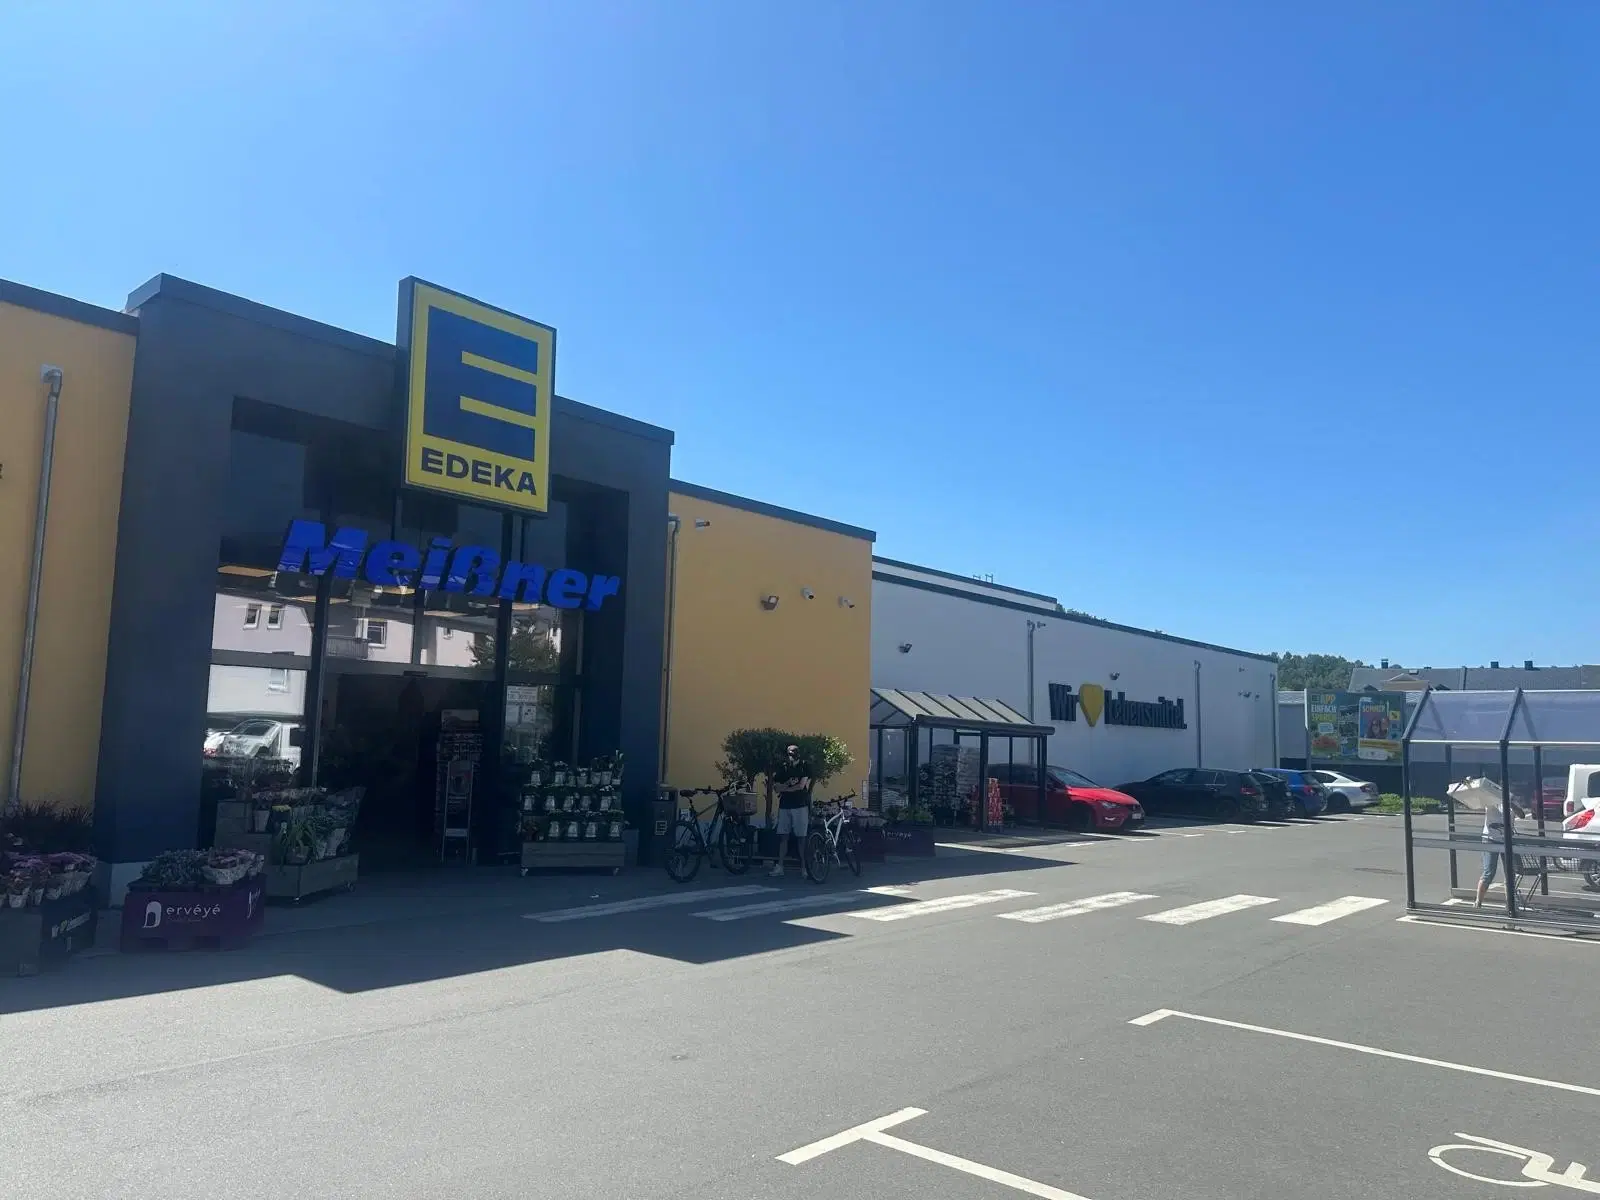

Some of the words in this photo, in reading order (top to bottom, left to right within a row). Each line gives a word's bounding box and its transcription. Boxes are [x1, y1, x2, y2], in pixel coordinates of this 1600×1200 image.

[421, 447, 537, 496] EDEKA
[276, 519, 621, 612] Meißner
[1049, 682, 1080, 722] Wir
